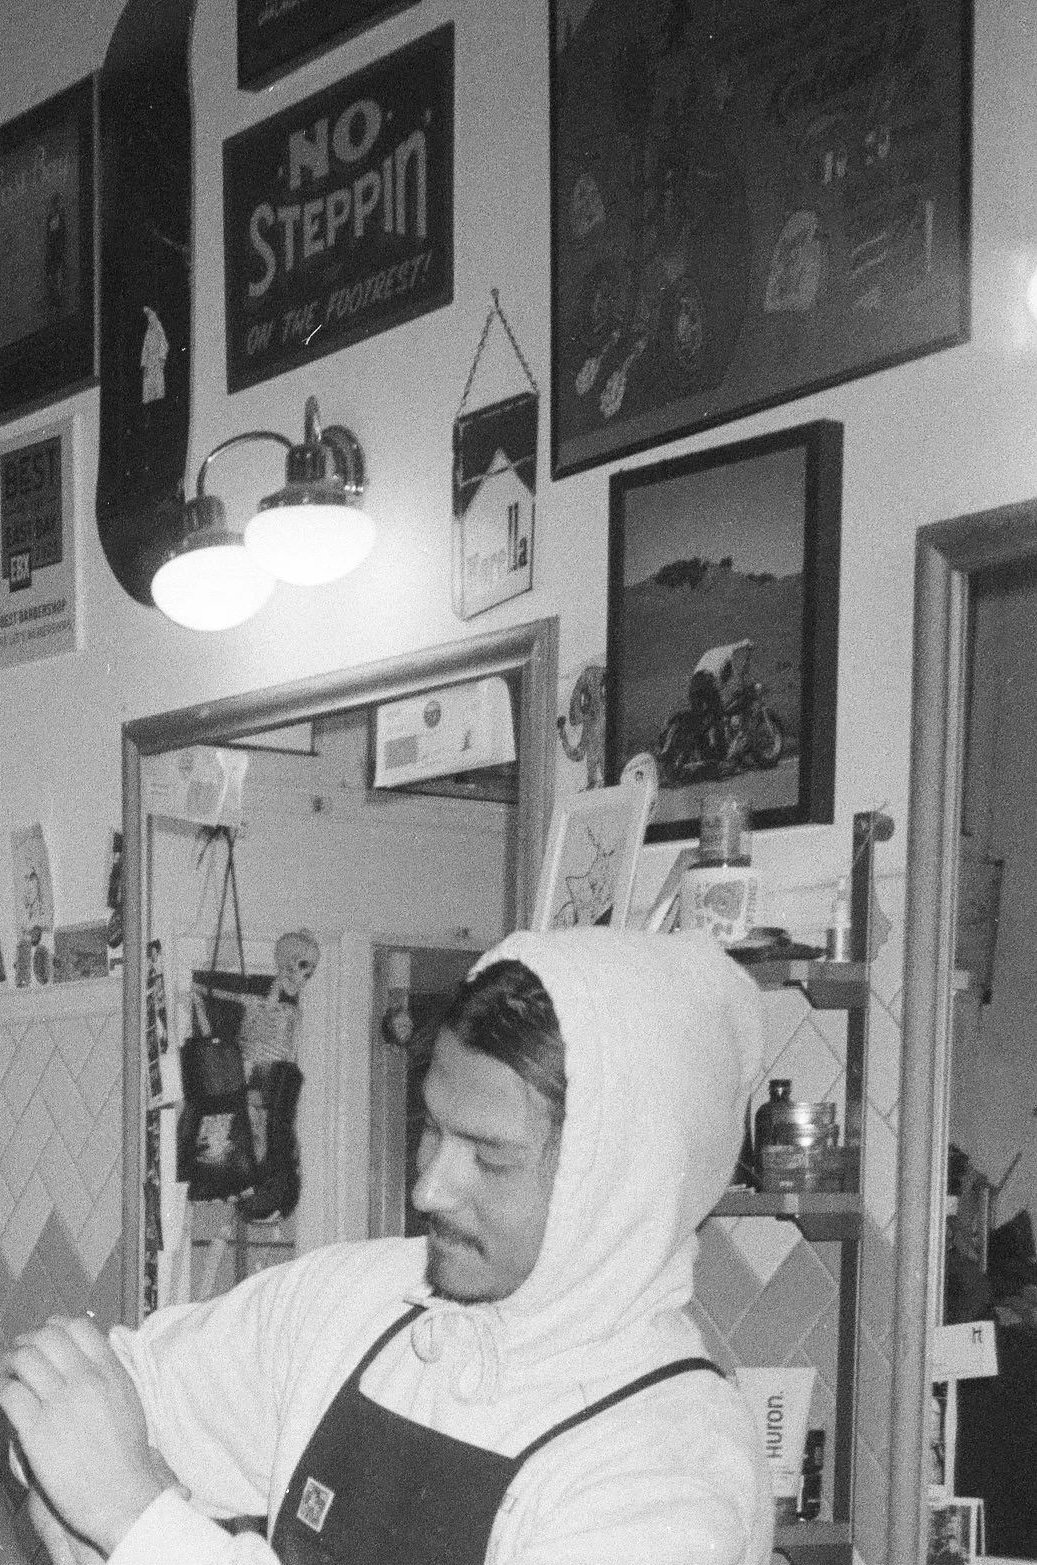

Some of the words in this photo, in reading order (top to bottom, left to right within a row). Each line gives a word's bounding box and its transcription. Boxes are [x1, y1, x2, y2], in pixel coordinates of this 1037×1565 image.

[289, 98, 384, 191] NO
[280, 299, 320, 344] THE
[324, 248, 434, 325] FOOTREST!
